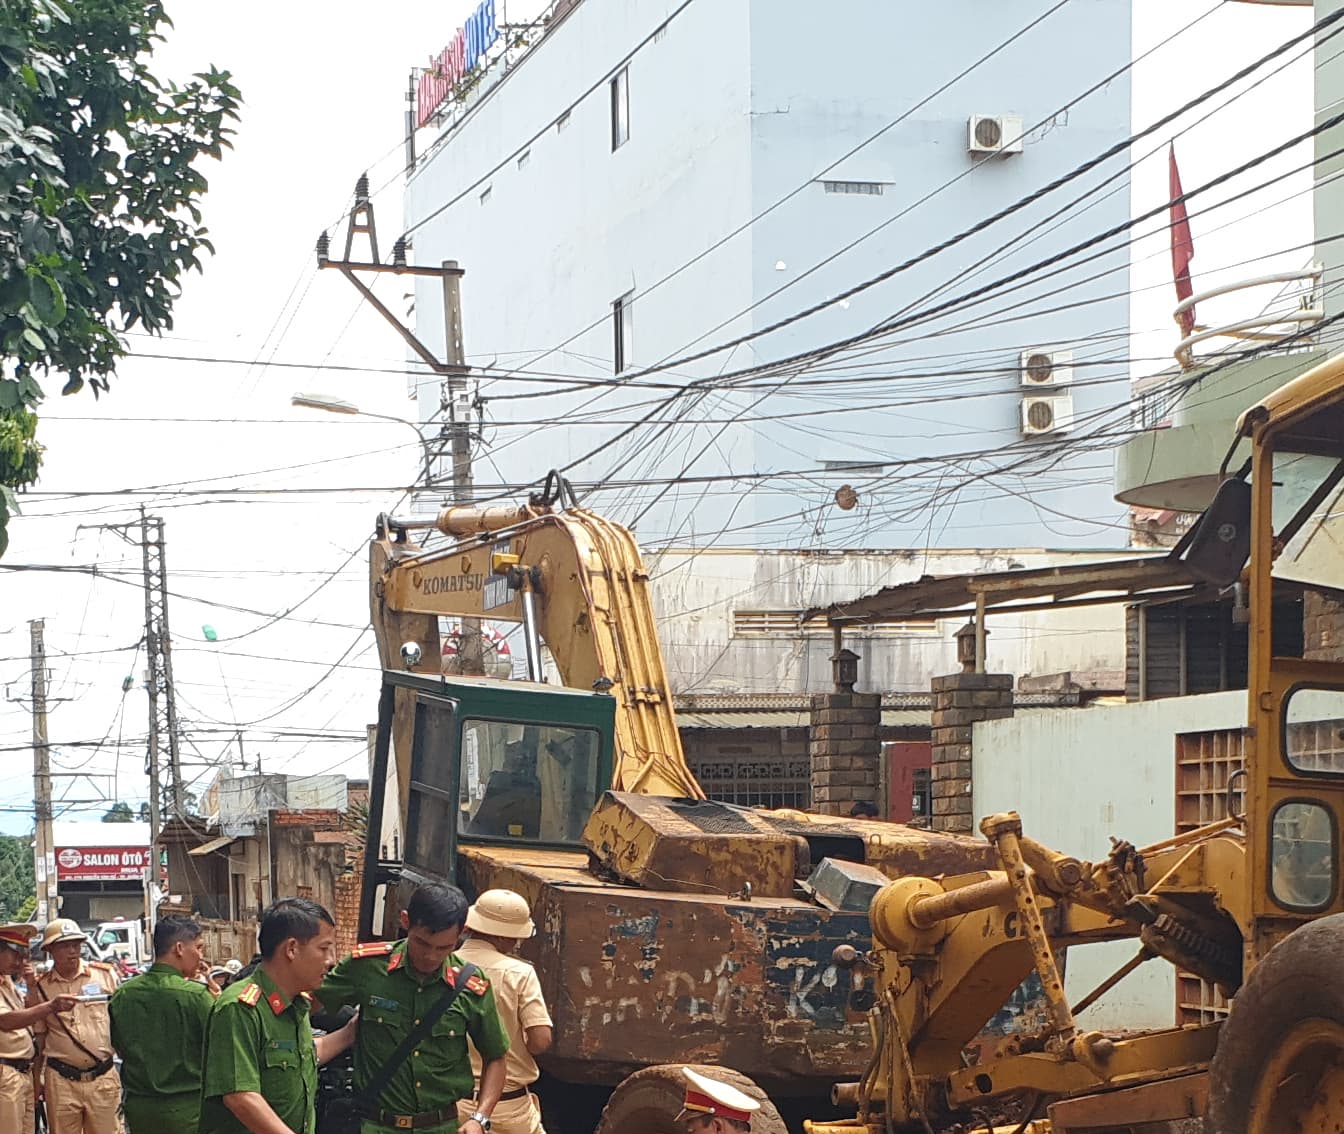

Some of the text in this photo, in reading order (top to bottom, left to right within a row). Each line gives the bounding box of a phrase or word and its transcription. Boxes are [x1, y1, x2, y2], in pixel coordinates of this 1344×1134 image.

[464, 0, 500, 73] HOTEL
[423, 573, 484, 595] KOMATSU
[83, 853, 119, 866] SALON
[121, 851, 143, 866] ÔTÔ
